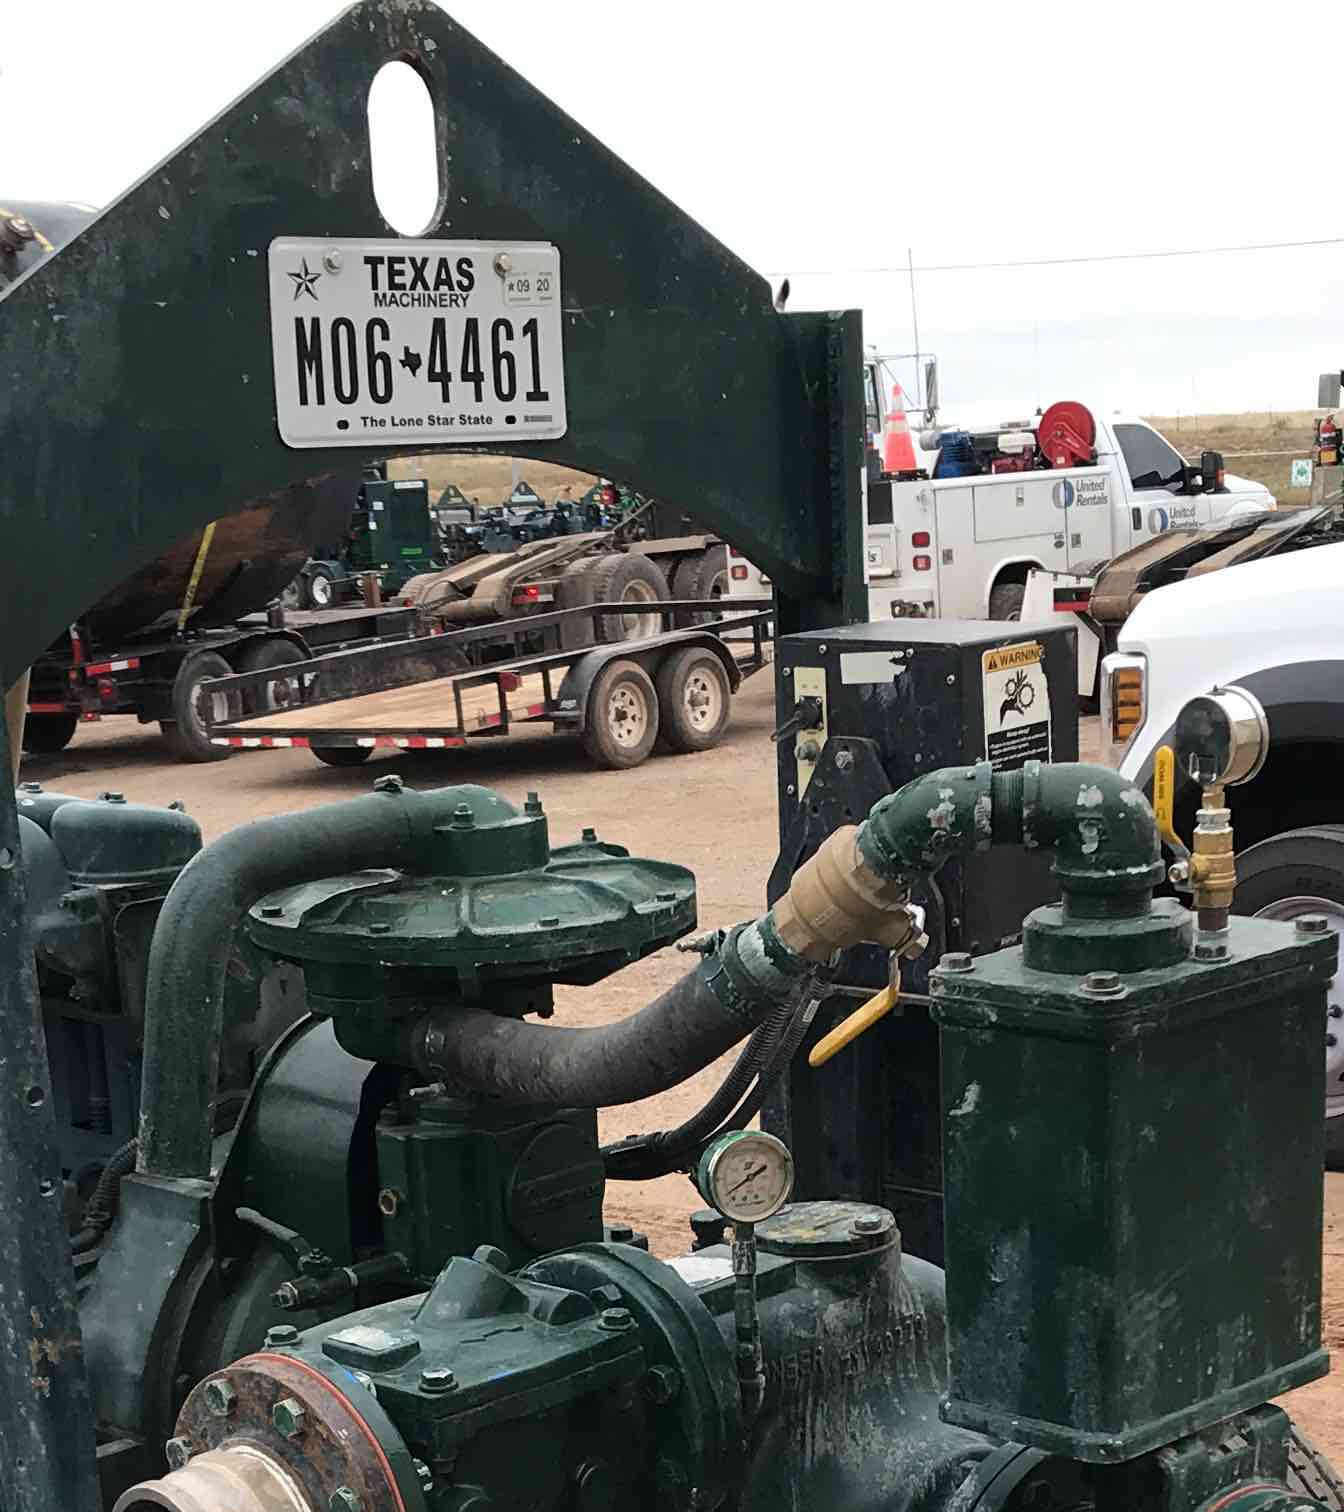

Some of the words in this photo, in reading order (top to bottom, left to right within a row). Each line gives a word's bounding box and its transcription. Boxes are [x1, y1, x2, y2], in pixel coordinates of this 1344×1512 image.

[364, 255, 475, 292] TEXAS
[373, 292, 470, 308] MACHINERY
[294, 317, 393, 406] M06
[427, 317, 549, 403] 4461
[360, 416, 387, 428] The
[391, 415, 423, 427] Lone
[427, 414, 455, 426] Star
[459, 413, 493, 425] State
[1076, 479, 1105, 492] United
[1076, 494, 1108, 506] Rentals
